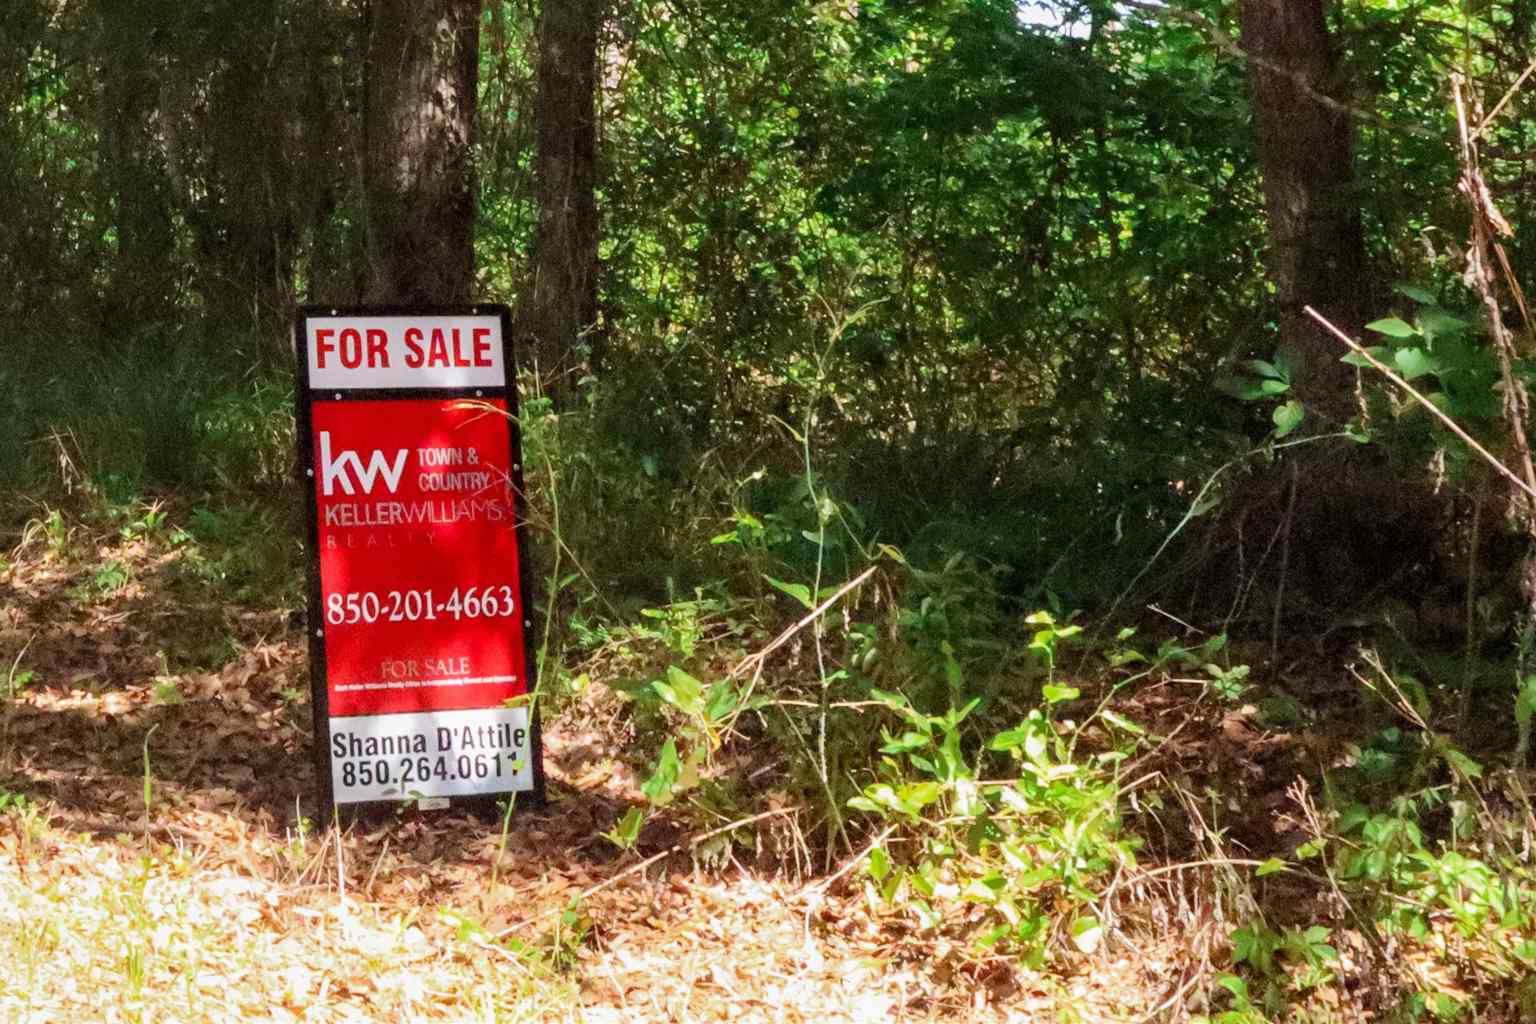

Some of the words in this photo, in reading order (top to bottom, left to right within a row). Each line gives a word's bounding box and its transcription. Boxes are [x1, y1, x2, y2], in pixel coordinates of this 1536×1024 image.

[316, 328, 390, 368] FOR
[404, 328, 493, 368] SALE
[320, 431, 409, 496] kw
[418, 447, 463, 466] TOWN
[467, 447, 480, 464] &
[418, 471, 490, 492] COUNTRY
[327, 585, 514, 625] 850-201-4663
[381, 660, 419, 679] FOR
[424, 657, 471, 676] SALE
[332, 732, 427, 758] Shanna
[437, 723, 526, 752] D'Attile
